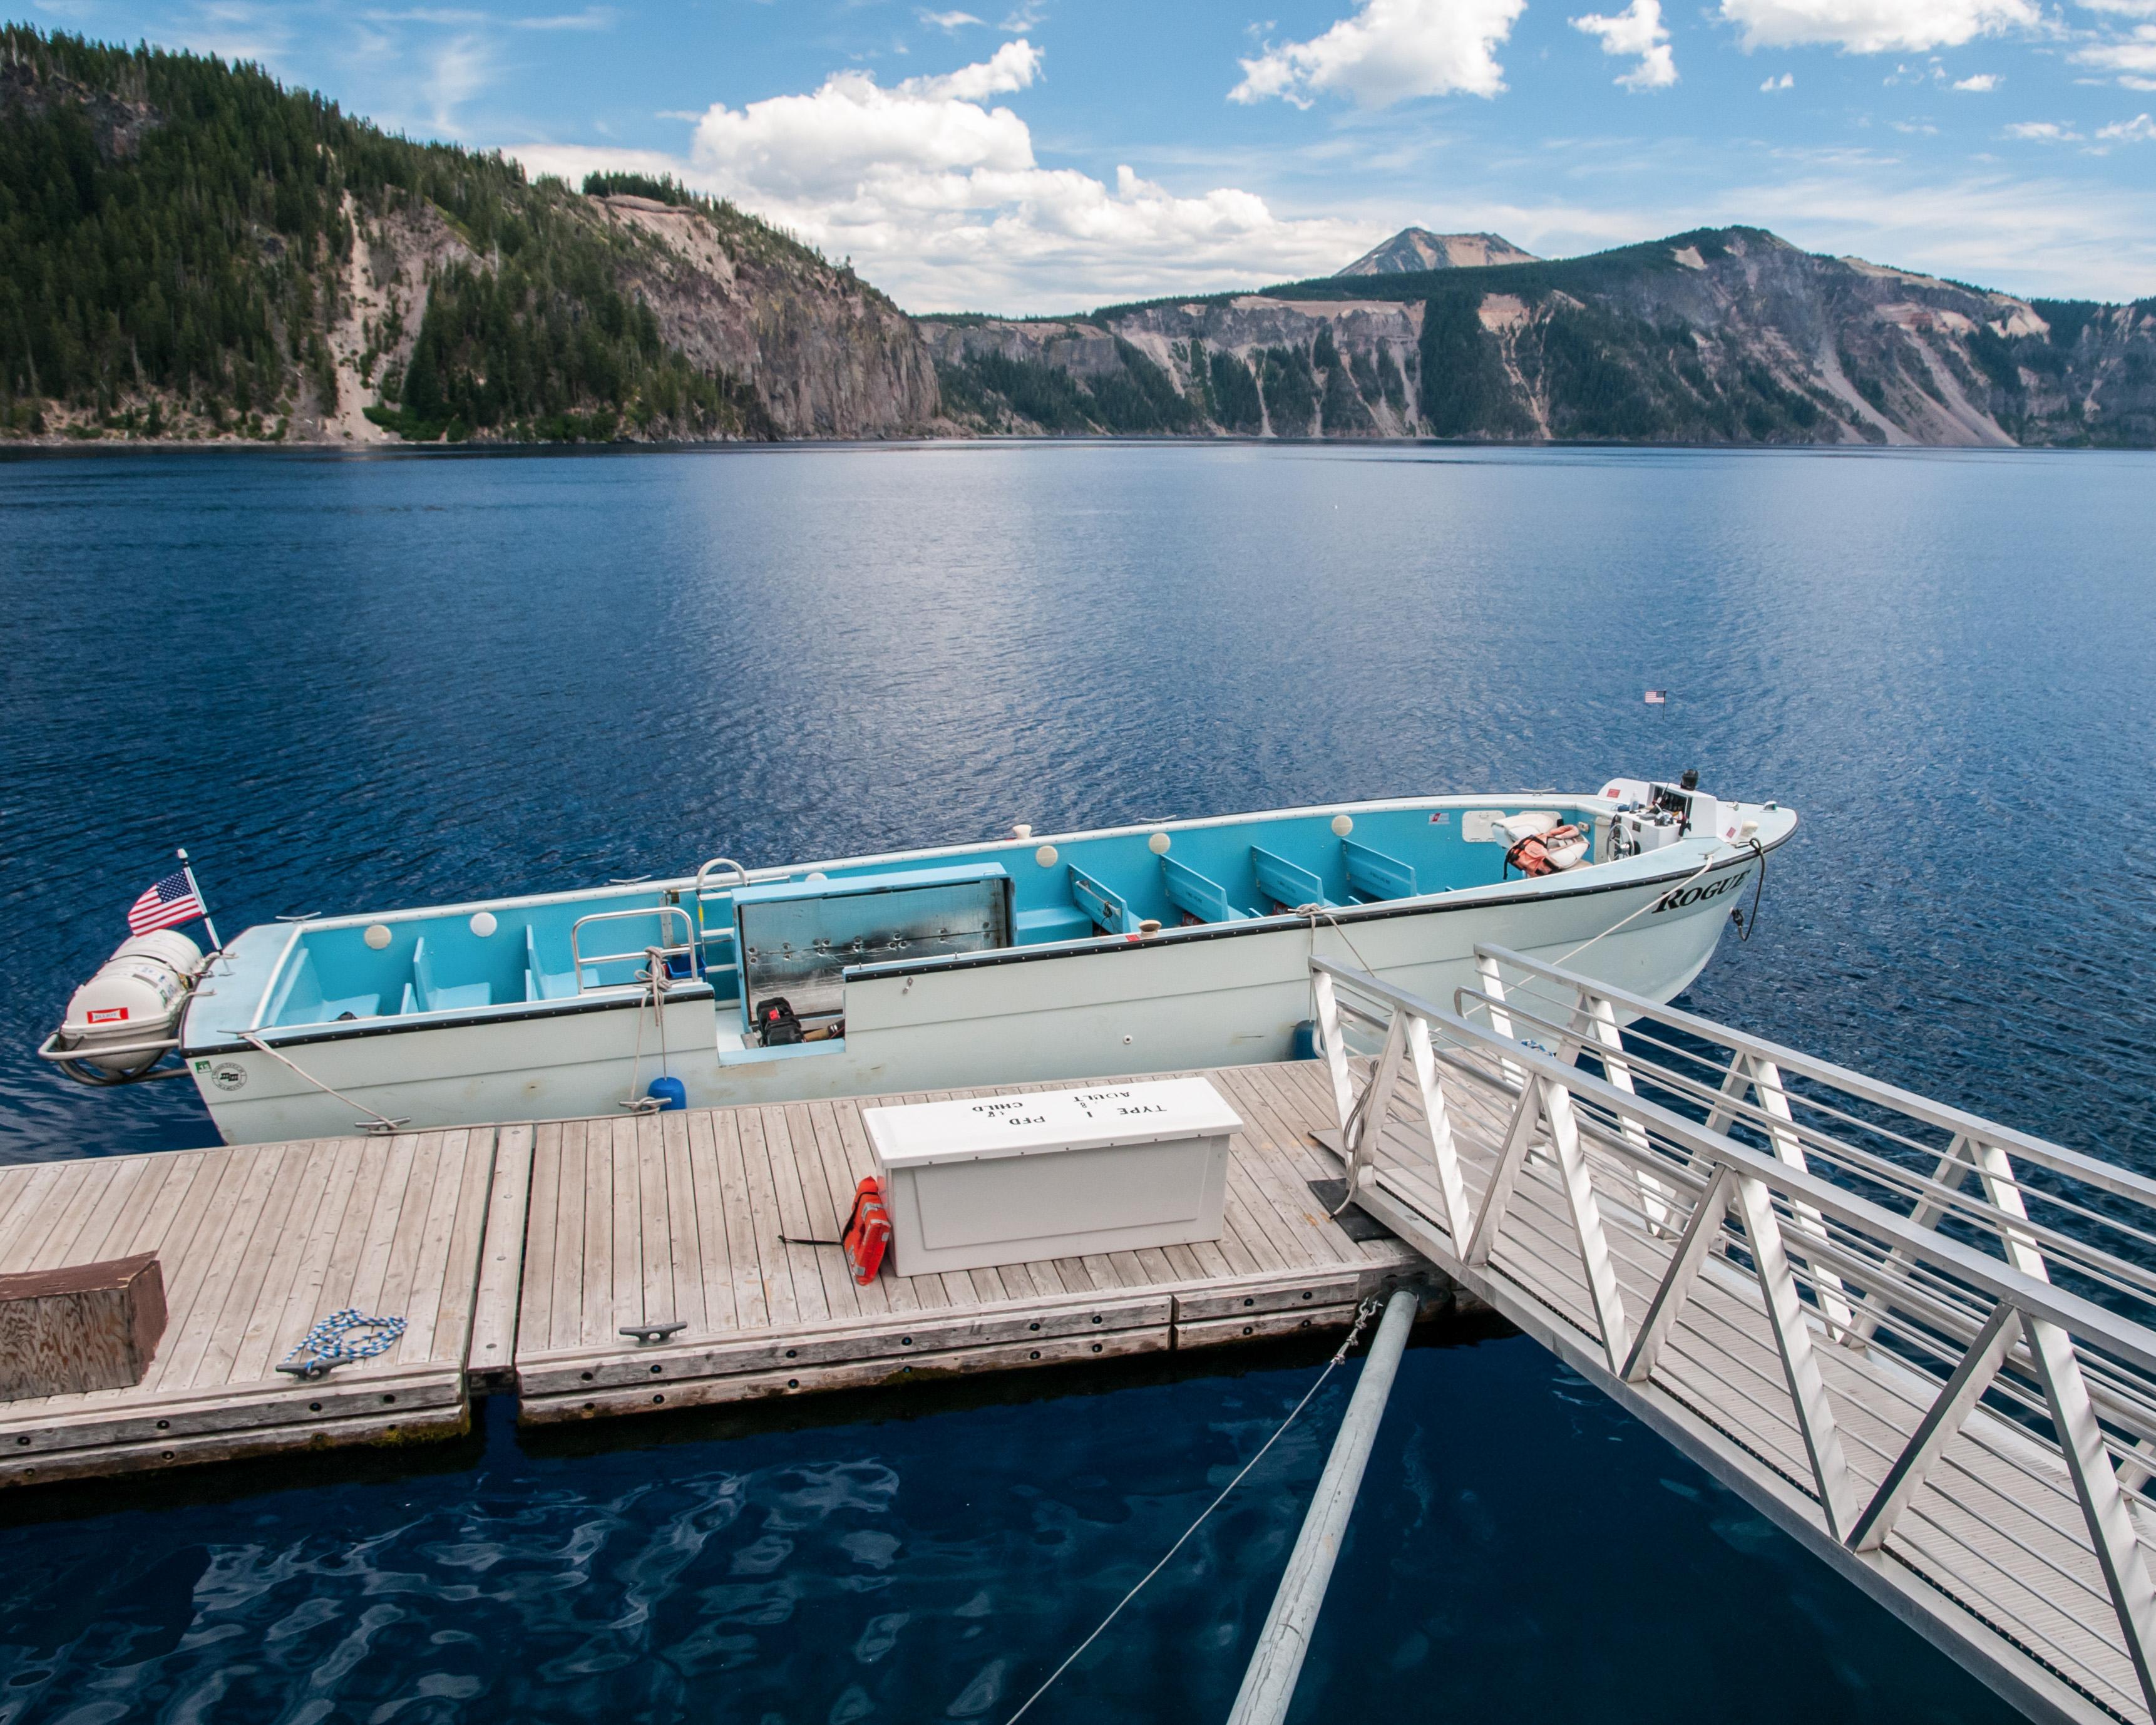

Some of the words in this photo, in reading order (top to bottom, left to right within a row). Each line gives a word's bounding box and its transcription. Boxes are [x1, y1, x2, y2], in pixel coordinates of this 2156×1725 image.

[1651, 869, 1752, 914] ROGUE
[1074, 1091, 1130, 1102] ADULT
[972, 1102, 1023, 1111] CHILD
[1117, 1105, 1167, 1115] TYPE
[1009, 1116, 1045, 1125] PFD
